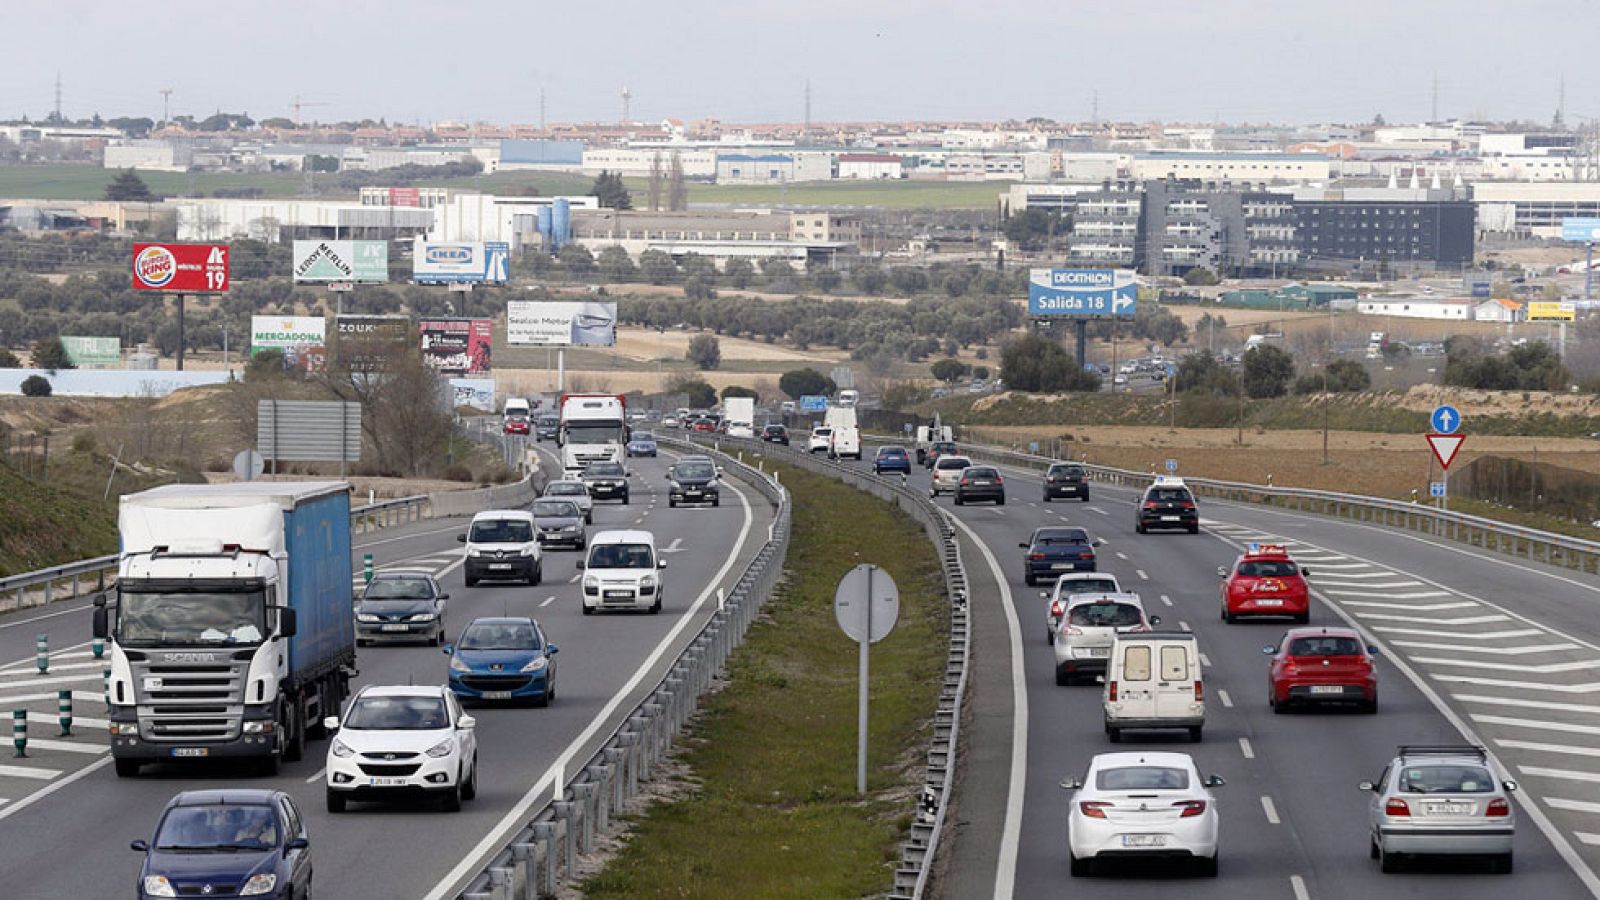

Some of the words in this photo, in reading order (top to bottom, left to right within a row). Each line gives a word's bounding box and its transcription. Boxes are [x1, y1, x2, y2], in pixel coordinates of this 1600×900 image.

[141, 254, 170, 266] BURGER
[319, 243, 352, 276] MERLIN
[431, 250, 468, 259] IKEA
[142, 262, 171, 276] KING
[295, 249, 321, 277] LEROY
[205, 271, 225, 289] 19
[1054, 273, 1111, 283] DECATHLON
[1039, 296, 1082, 309] Salida
[1087, 297, 1104, 309] 18
[255, 332, 323, 341] MERCADONA
[164, 653, 215, 662] SCANIA
